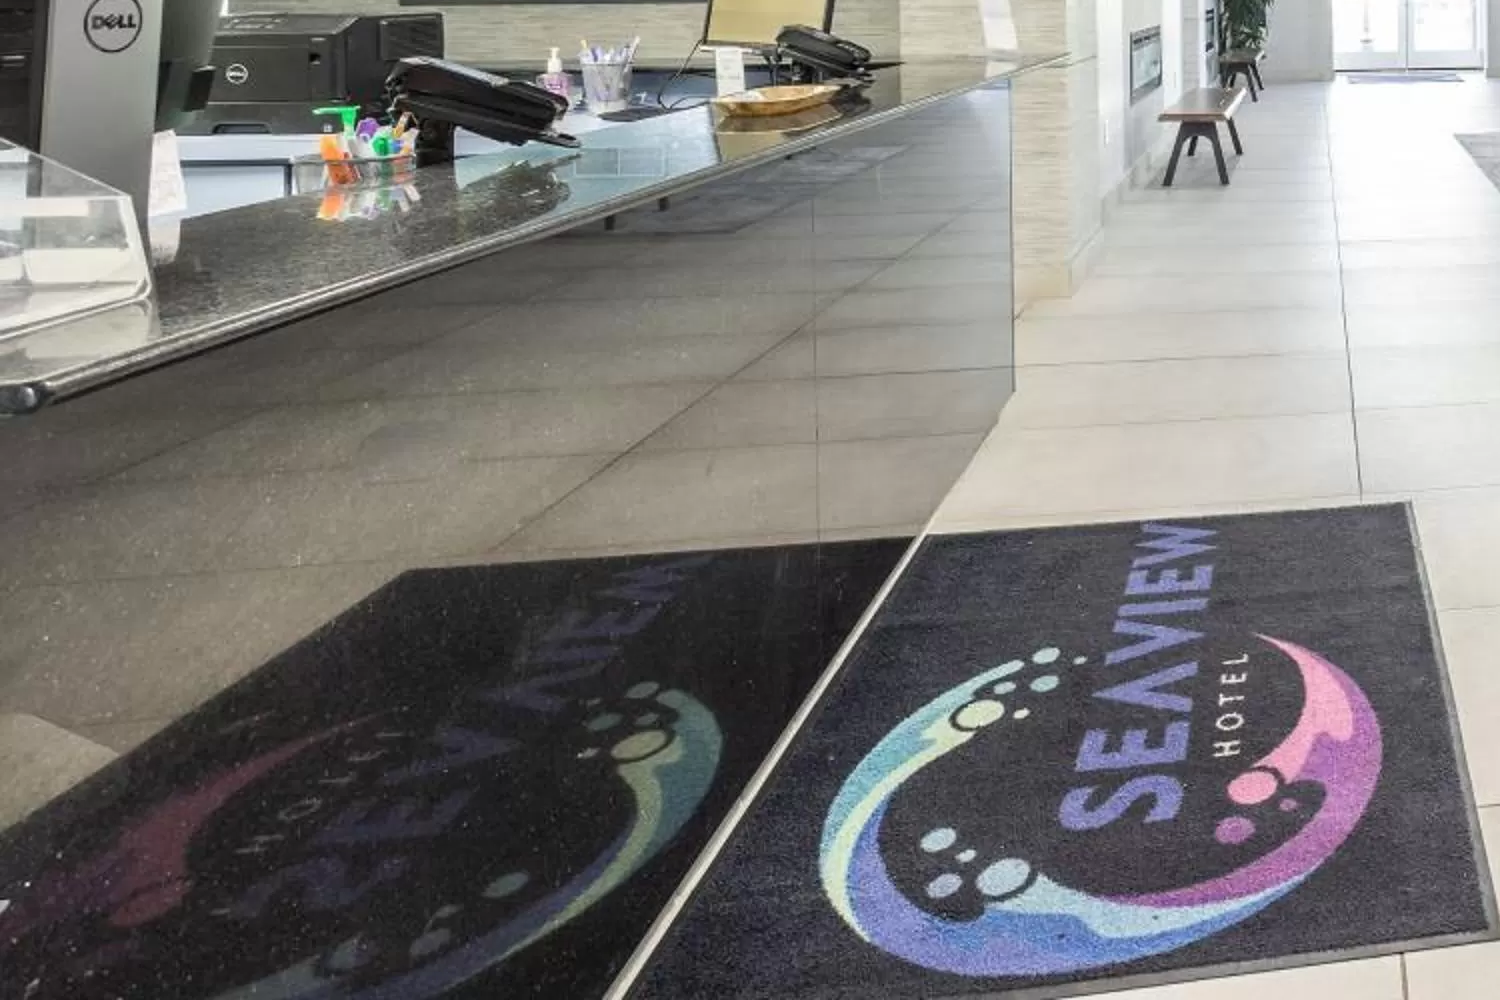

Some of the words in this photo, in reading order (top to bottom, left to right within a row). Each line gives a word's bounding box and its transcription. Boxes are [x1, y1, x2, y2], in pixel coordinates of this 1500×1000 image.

[92, 13, 137, 30] DELL
[1058, 522, 1217, 831] SEAVIEW
[1212, 651, 1249, 759] HOTEL
